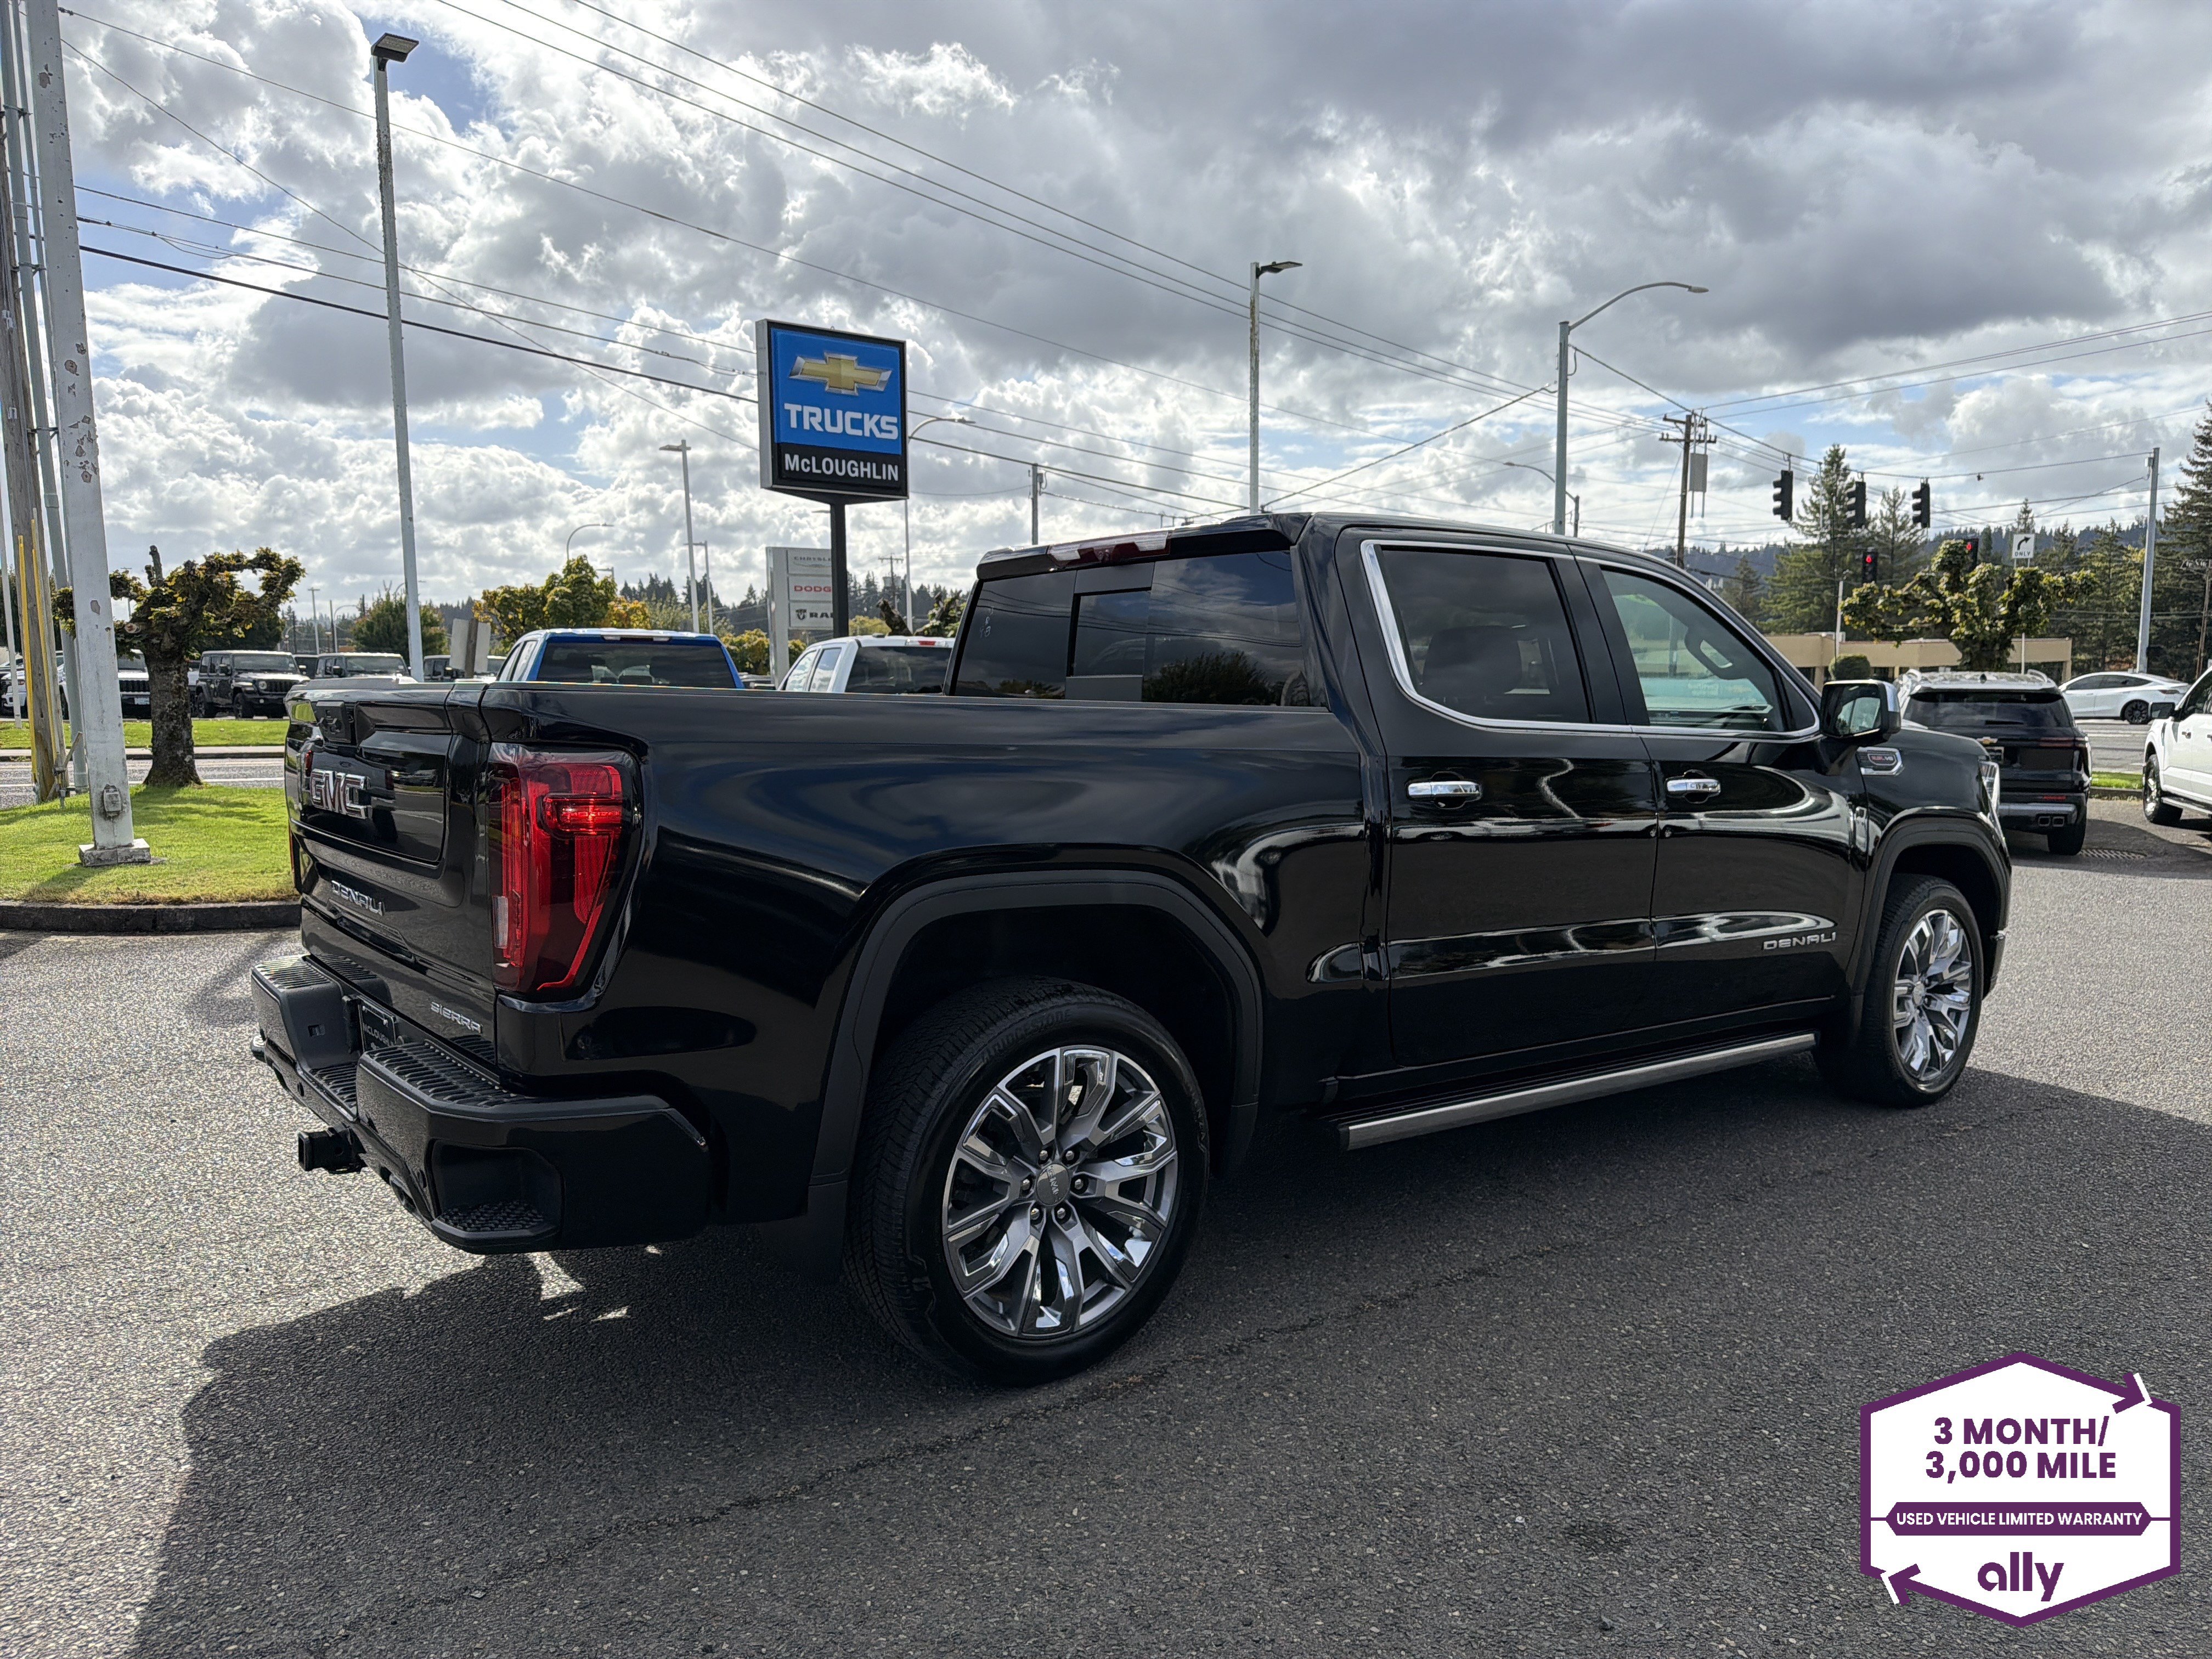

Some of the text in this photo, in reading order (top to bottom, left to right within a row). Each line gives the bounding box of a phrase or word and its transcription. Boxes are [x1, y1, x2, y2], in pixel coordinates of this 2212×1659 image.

[785, 404, 898, 439] TRUCKS
[785, 454, 898, 481] McLOUGHLIN
[310, 768, 370, 820] GMC
[331, 879, 383, 916] DENALI
[1763, 932, 1836, 950] DENALI
[430, 1001, 483, 1034] SIERRA
